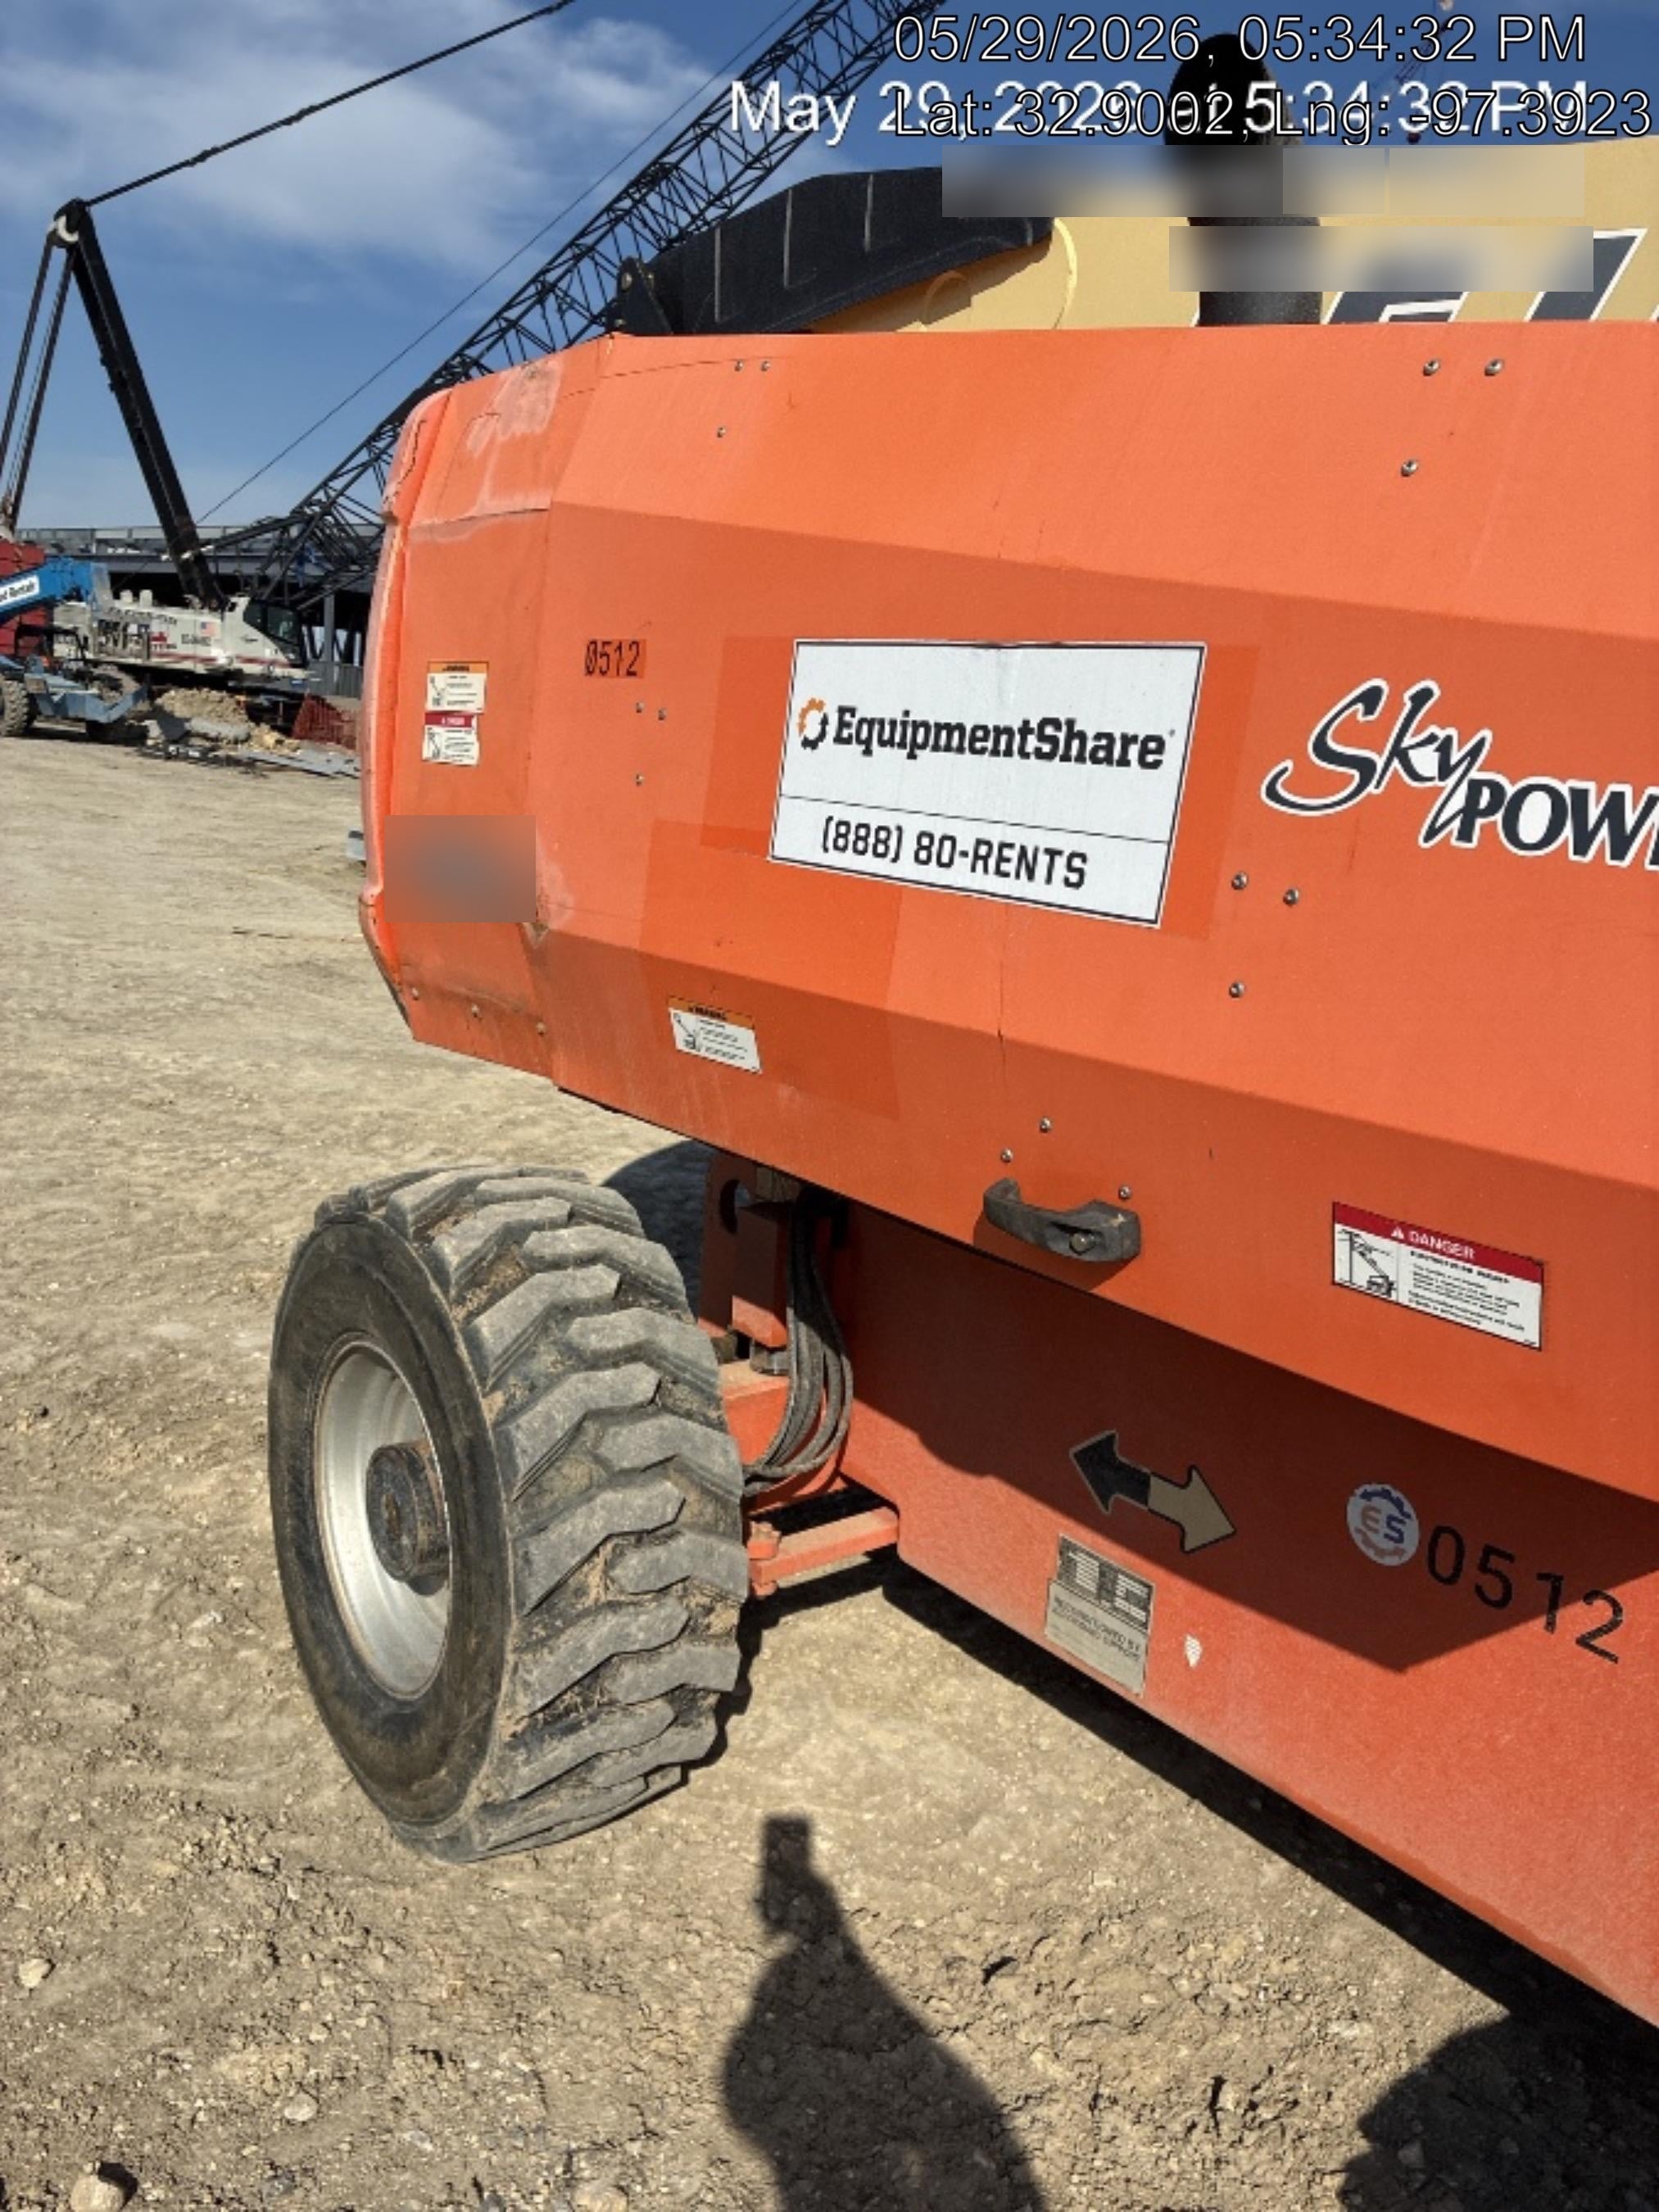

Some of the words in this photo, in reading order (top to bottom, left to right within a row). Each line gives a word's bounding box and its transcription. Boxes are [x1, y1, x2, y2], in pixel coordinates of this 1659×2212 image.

[584, 639, 641, 678] 0512
[832, 705, 1167, 771] EquipmentShare
[822, 816, 904, 863] (888)
[913, 831, 1090, 891] 80-RENTS
[1452, 772, 1659, 872] POW
[1408, 1230, 1475, 1260] DANGER
[1426, 1525, 1625, 1665] 0512
